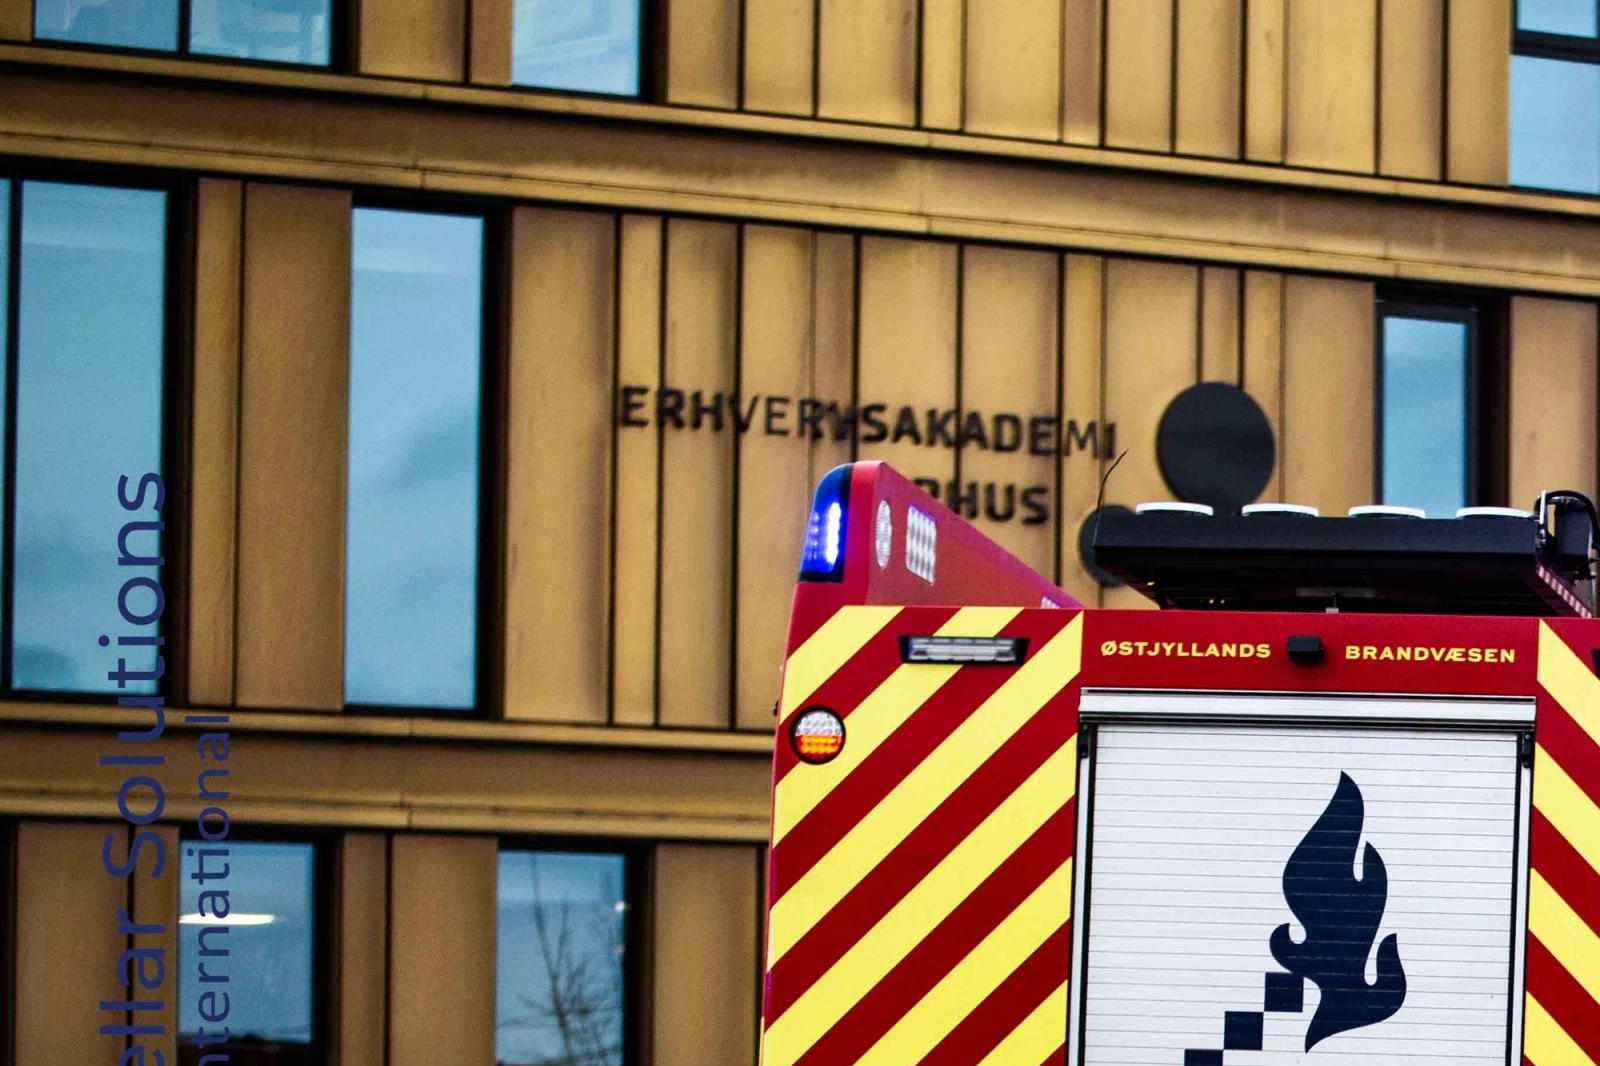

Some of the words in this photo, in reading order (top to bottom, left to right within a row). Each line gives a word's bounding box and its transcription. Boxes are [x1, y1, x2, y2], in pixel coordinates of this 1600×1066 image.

[620, 387, 1117, 460] ERHVERVSAKADEMI
[1101, 640, 1271, 658] ØSTJYLLANDS
[1345, 645, 1516, 663] BRANDVÆSEN
